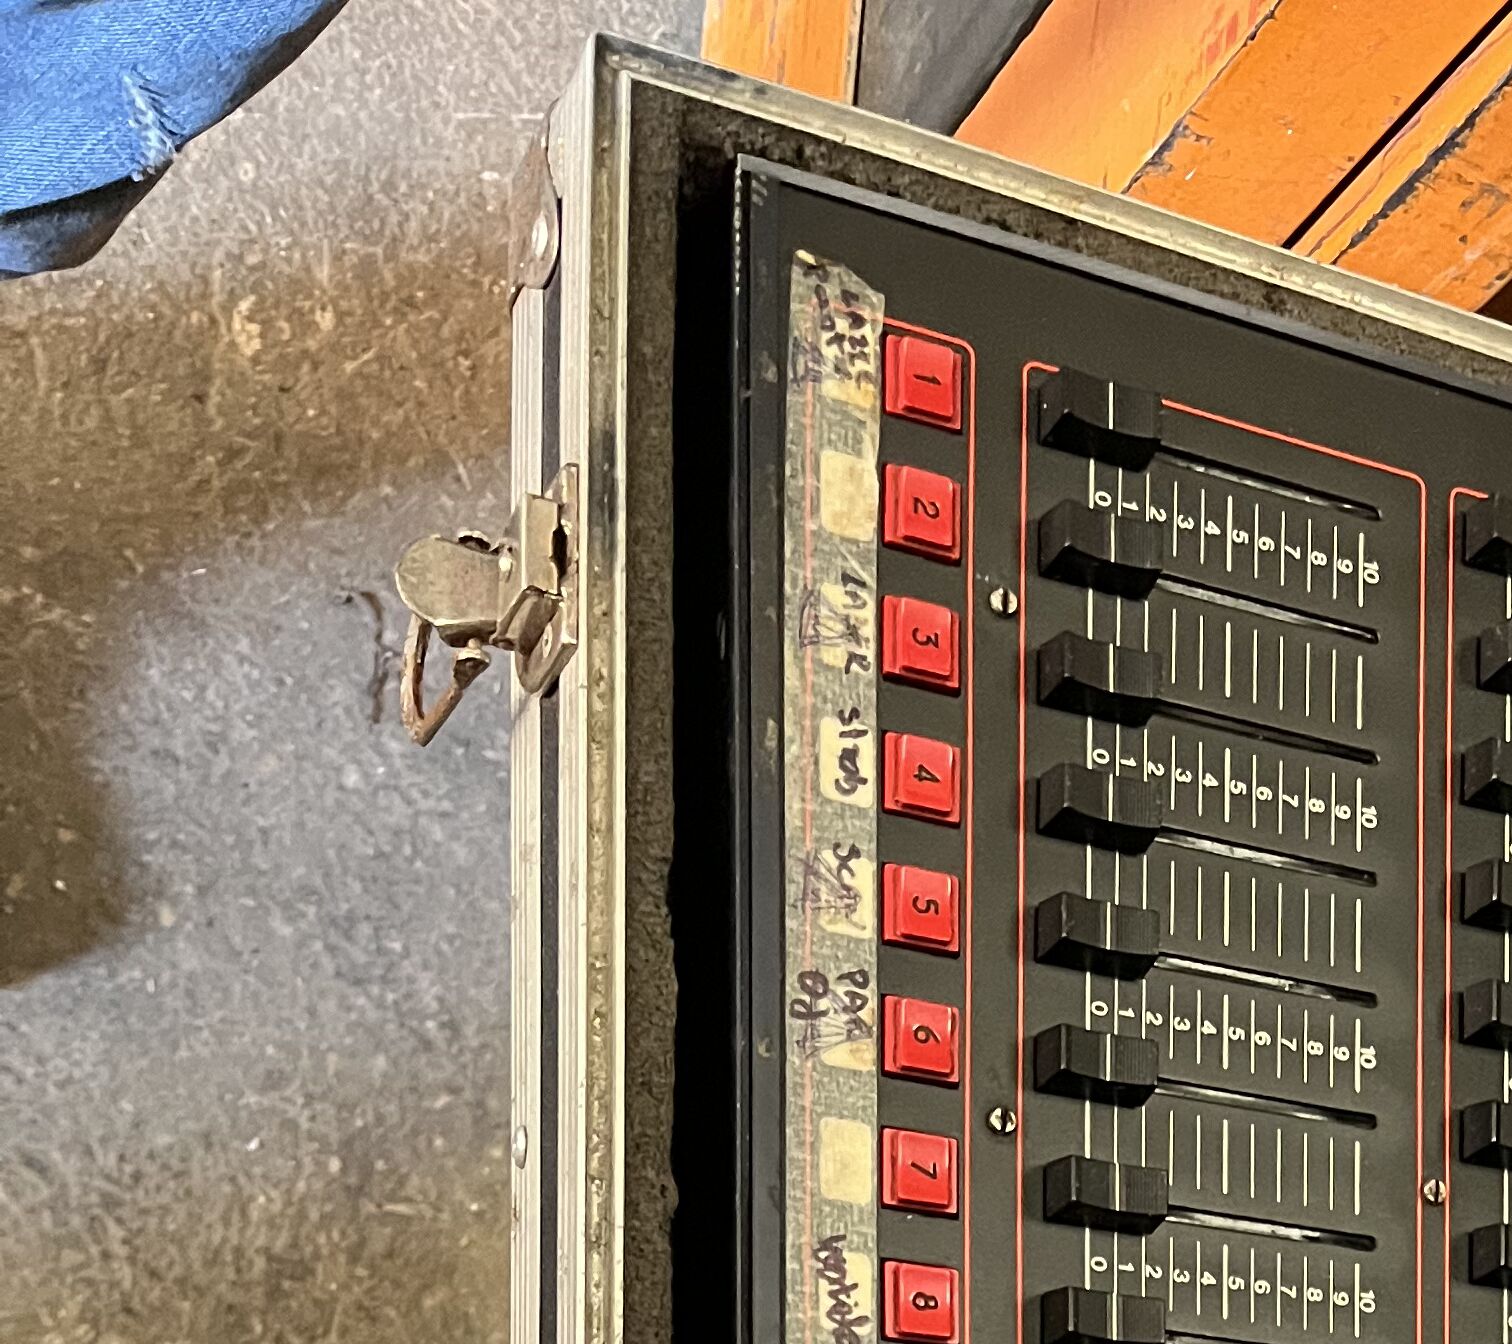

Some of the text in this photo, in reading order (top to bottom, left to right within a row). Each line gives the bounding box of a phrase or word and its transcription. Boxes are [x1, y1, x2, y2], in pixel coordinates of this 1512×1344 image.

[912, 373, 942, 386] 1
[1093, 490, 1113, 508] 0
[912, 496, 940, 520] 2
[1149, 505, 1168, 523] 2
[1176, 513, 1195, 530] 3
[1203, 519, 1222, 536] 4
[1231, 528, 1250, 545] 5
[1257, 535, 1276, 552] 6
[1283, 544, 1301, 560] 7
[1310, 550, 1328, 567] 8
[1336, 557, 1354, 575] 9
[1362, 560, 1380, 585] 10
[911, 627, 940, 649] 3
[912, 763, 941, 784] 4
[911, 895, 940, 916] 5
[912, 1024, 941, 1045] 6
[910, 1161, 938, 1181] 7
[1089, 1255, 1108, 1273] 0
[1144, 1264, 1163, 1280] 2
[1172, 1268, 1191, 1284] 3
[1200, 1270, 1217, 1286] 4
[1227, 1275, 1245, 1291] 5
[1253, 1279, 1272, 1295] 6
[1279, 1284, 1297, 1299] 7
[1305, 1286, 1324, 1302] 8
[911, 1291, 939, 1312] 8
[1332, 1291, 1350, 1307] 9
[1359, 1289, 1376, 1314] 10
